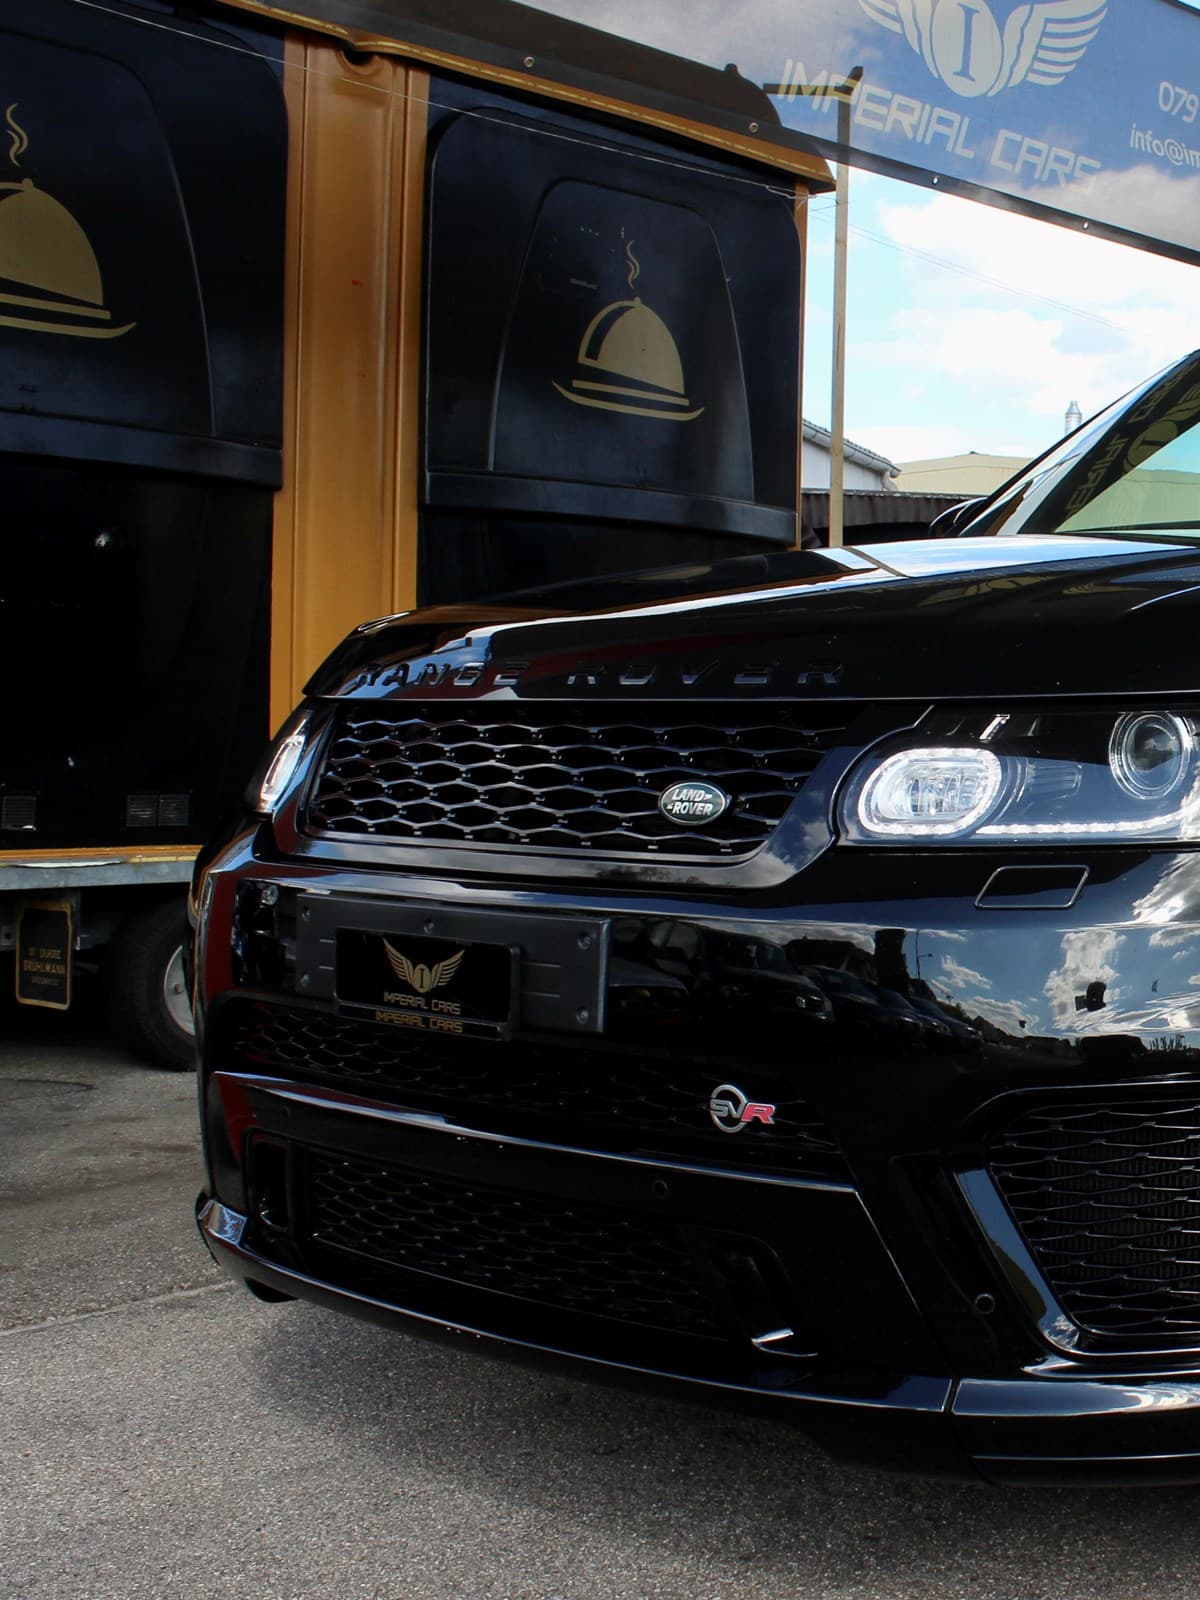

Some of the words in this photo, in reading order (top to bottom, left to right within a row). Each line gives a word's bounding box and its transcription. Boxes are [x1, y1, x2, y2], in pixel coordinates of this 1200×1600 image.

[1158, 81, 1199, 123] 079
[777, 58, 975, 159] IMPERIAL
[990, 128, 1102, 193] CARS
[355, 662, 527, 687] RANGE
[671, 788, 706, 802] LAND
[671, 801, 714, 816] ROVER
[383, 991, 429, 1010] IMPERIAL
[431, 999, 461, 1016] CARS
[375, 1010, 425, 1028] IMPERIAL
[429, 1017, 464, 1033] CARS
[709, 1098, 776, 1125] SVR
